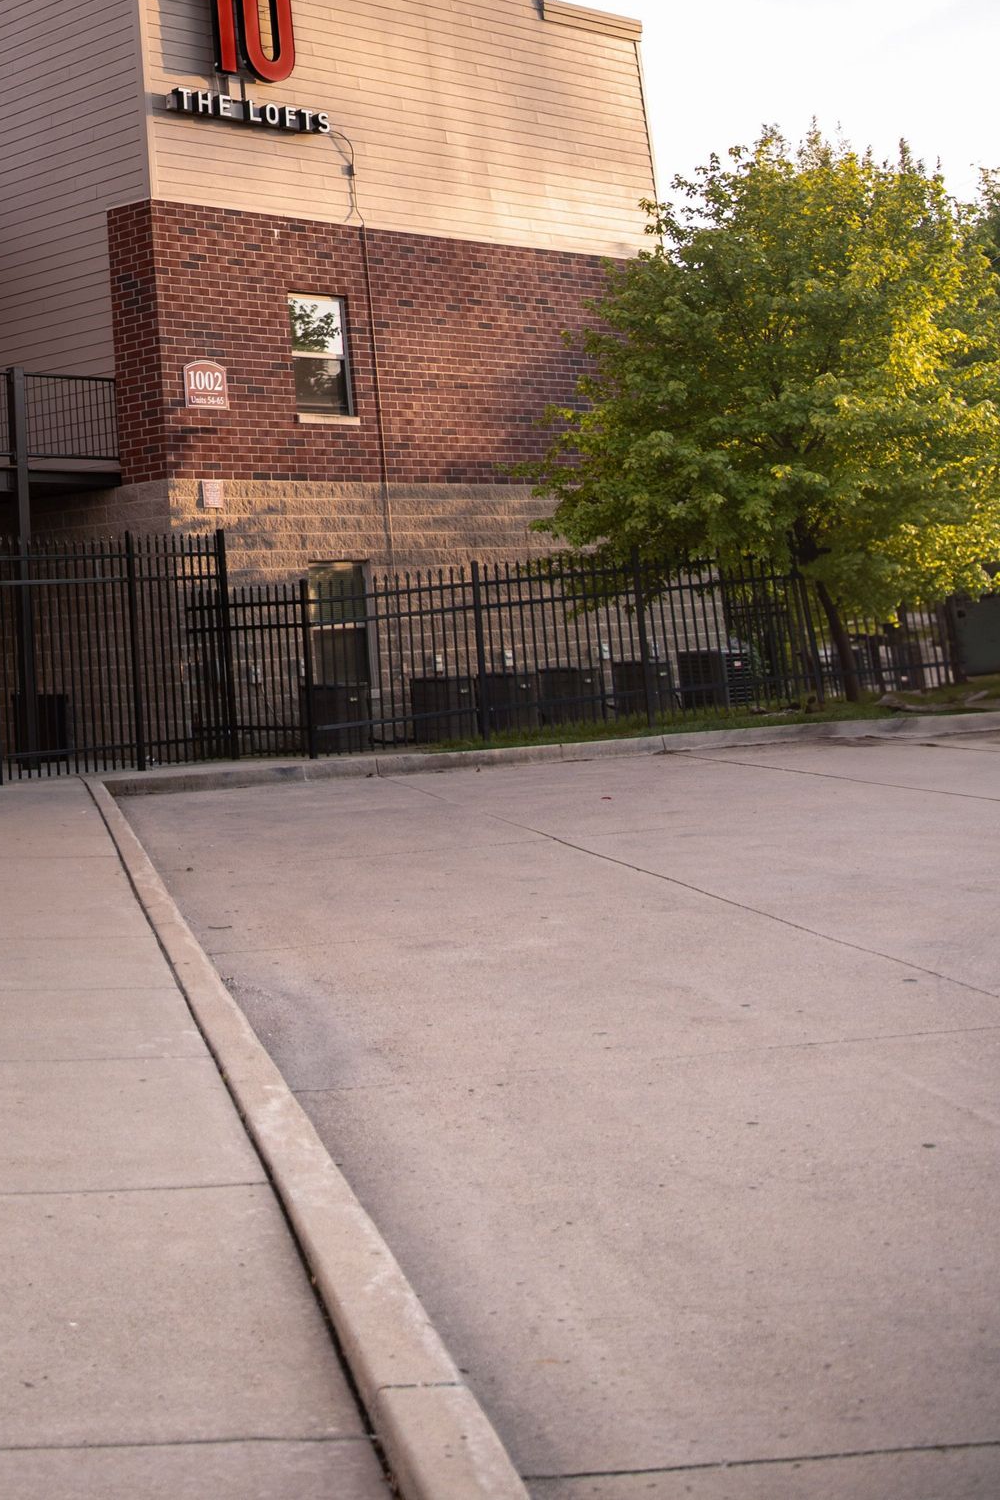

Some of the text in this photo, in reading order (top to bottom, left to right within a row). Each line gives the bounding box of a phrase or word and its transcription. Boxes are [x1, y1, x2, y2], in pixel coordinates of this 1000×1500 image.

[177, 87, 331, 133] THE LOFTS
[188, 370, 223, 391] 1002
[190, 395, 207, 404] Units
